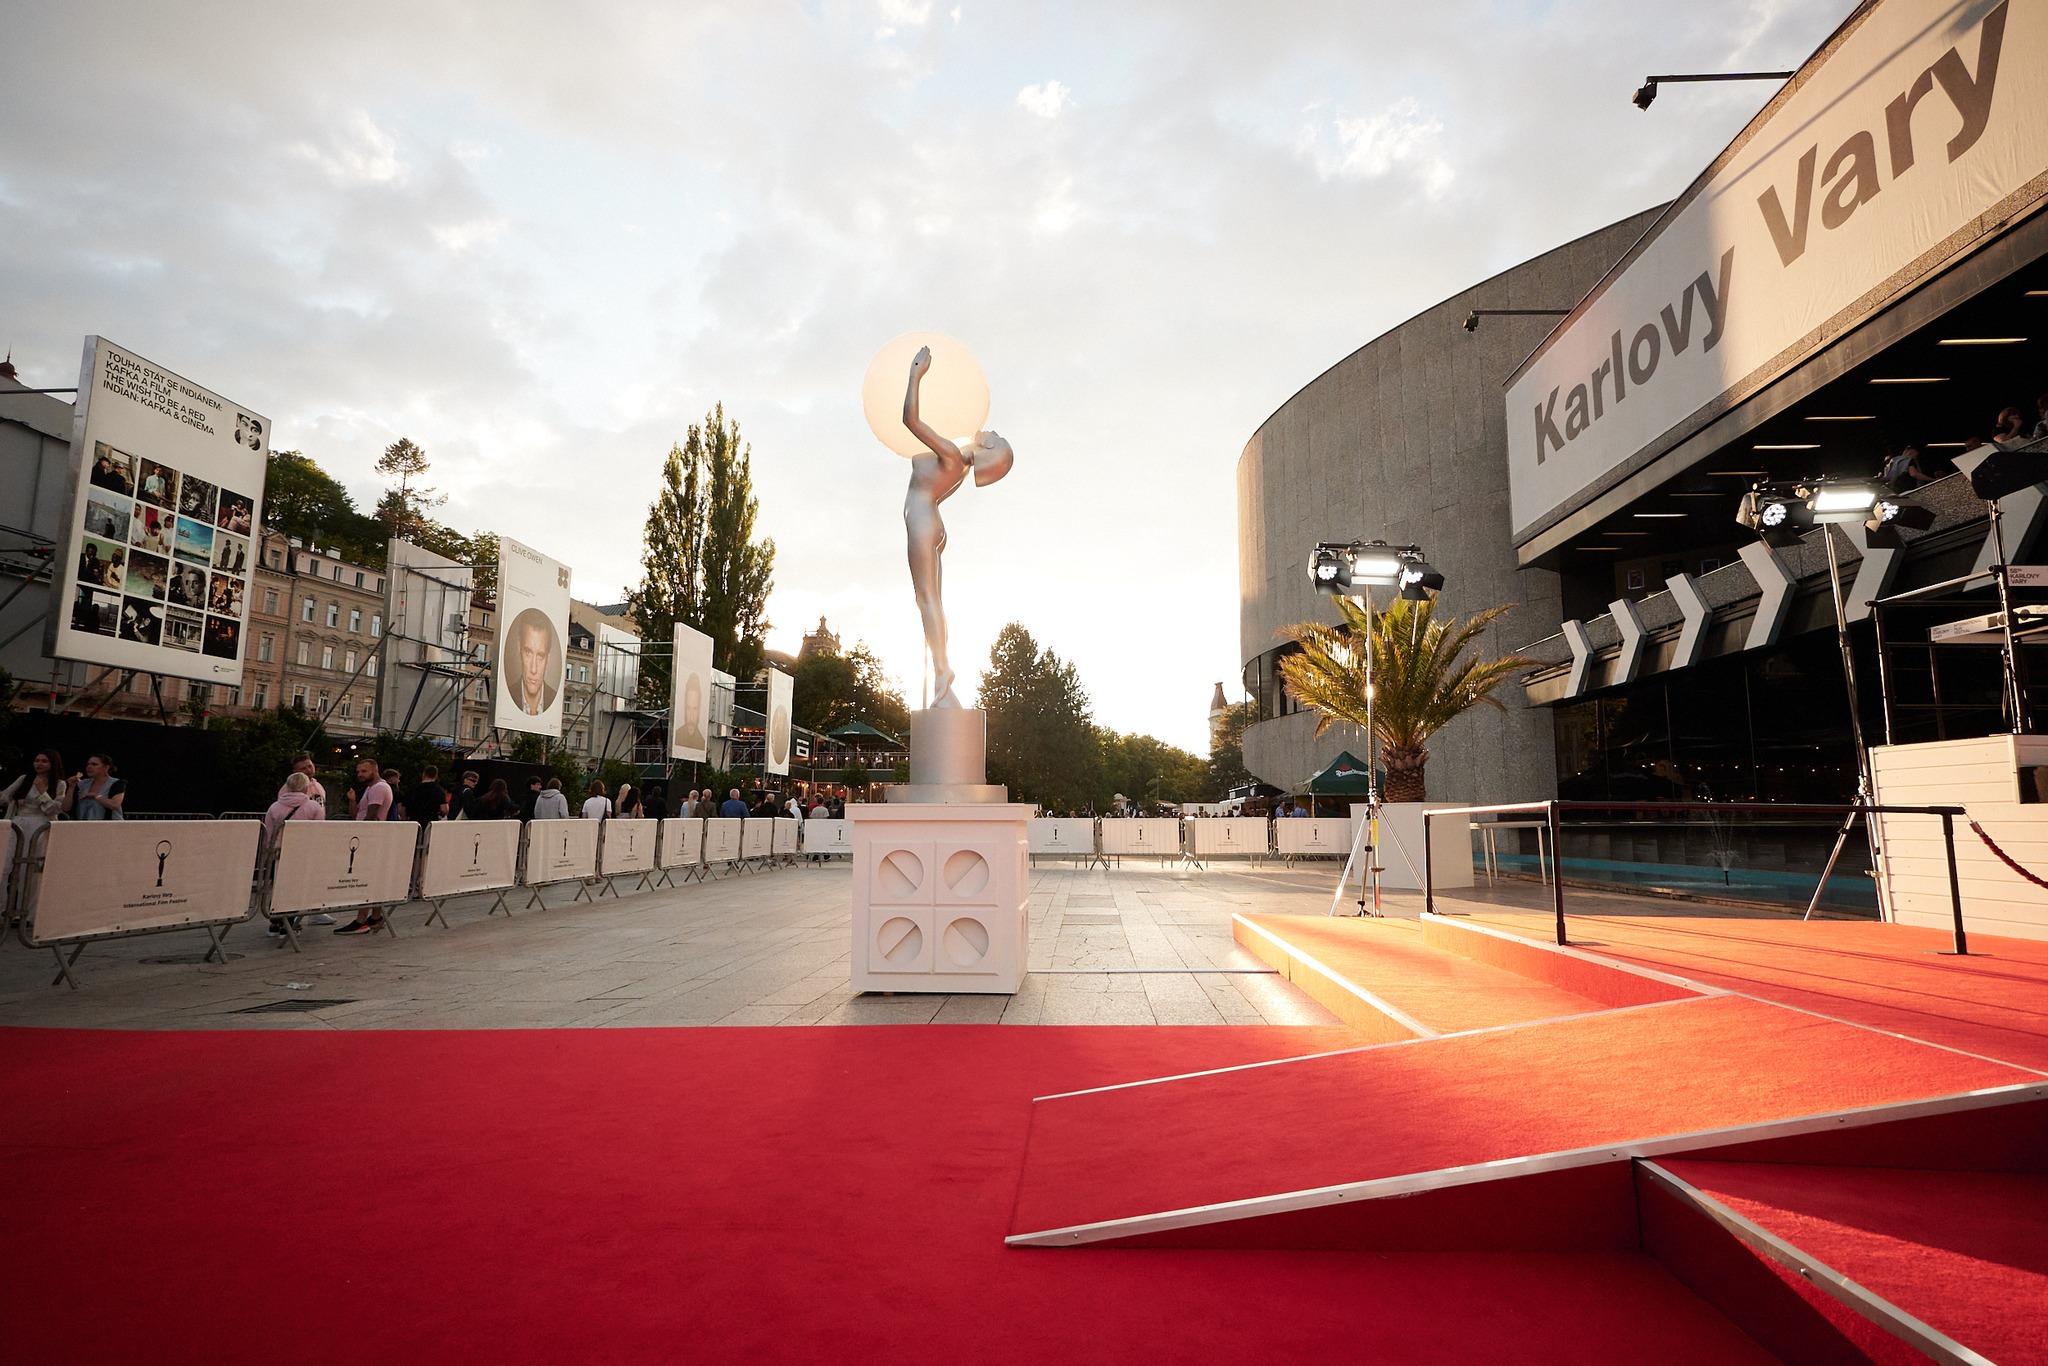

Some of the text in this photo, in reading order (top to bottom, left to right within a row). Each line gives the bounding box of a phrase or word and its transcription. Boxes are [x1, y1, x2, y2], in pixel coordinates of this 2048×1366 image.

[1533, 0, 2010, 466] Karlovy Vary
[103, 379, 215, 436] INDIAN: KAFKA & CINEMA
[104, 369, 206, 422] THE WISH TO BE A RED
[105, 360, 172, 398] KAFKA A FILM
[107, 350, 223, 412] TOUHA STÁT SE INDIÁNEM:
